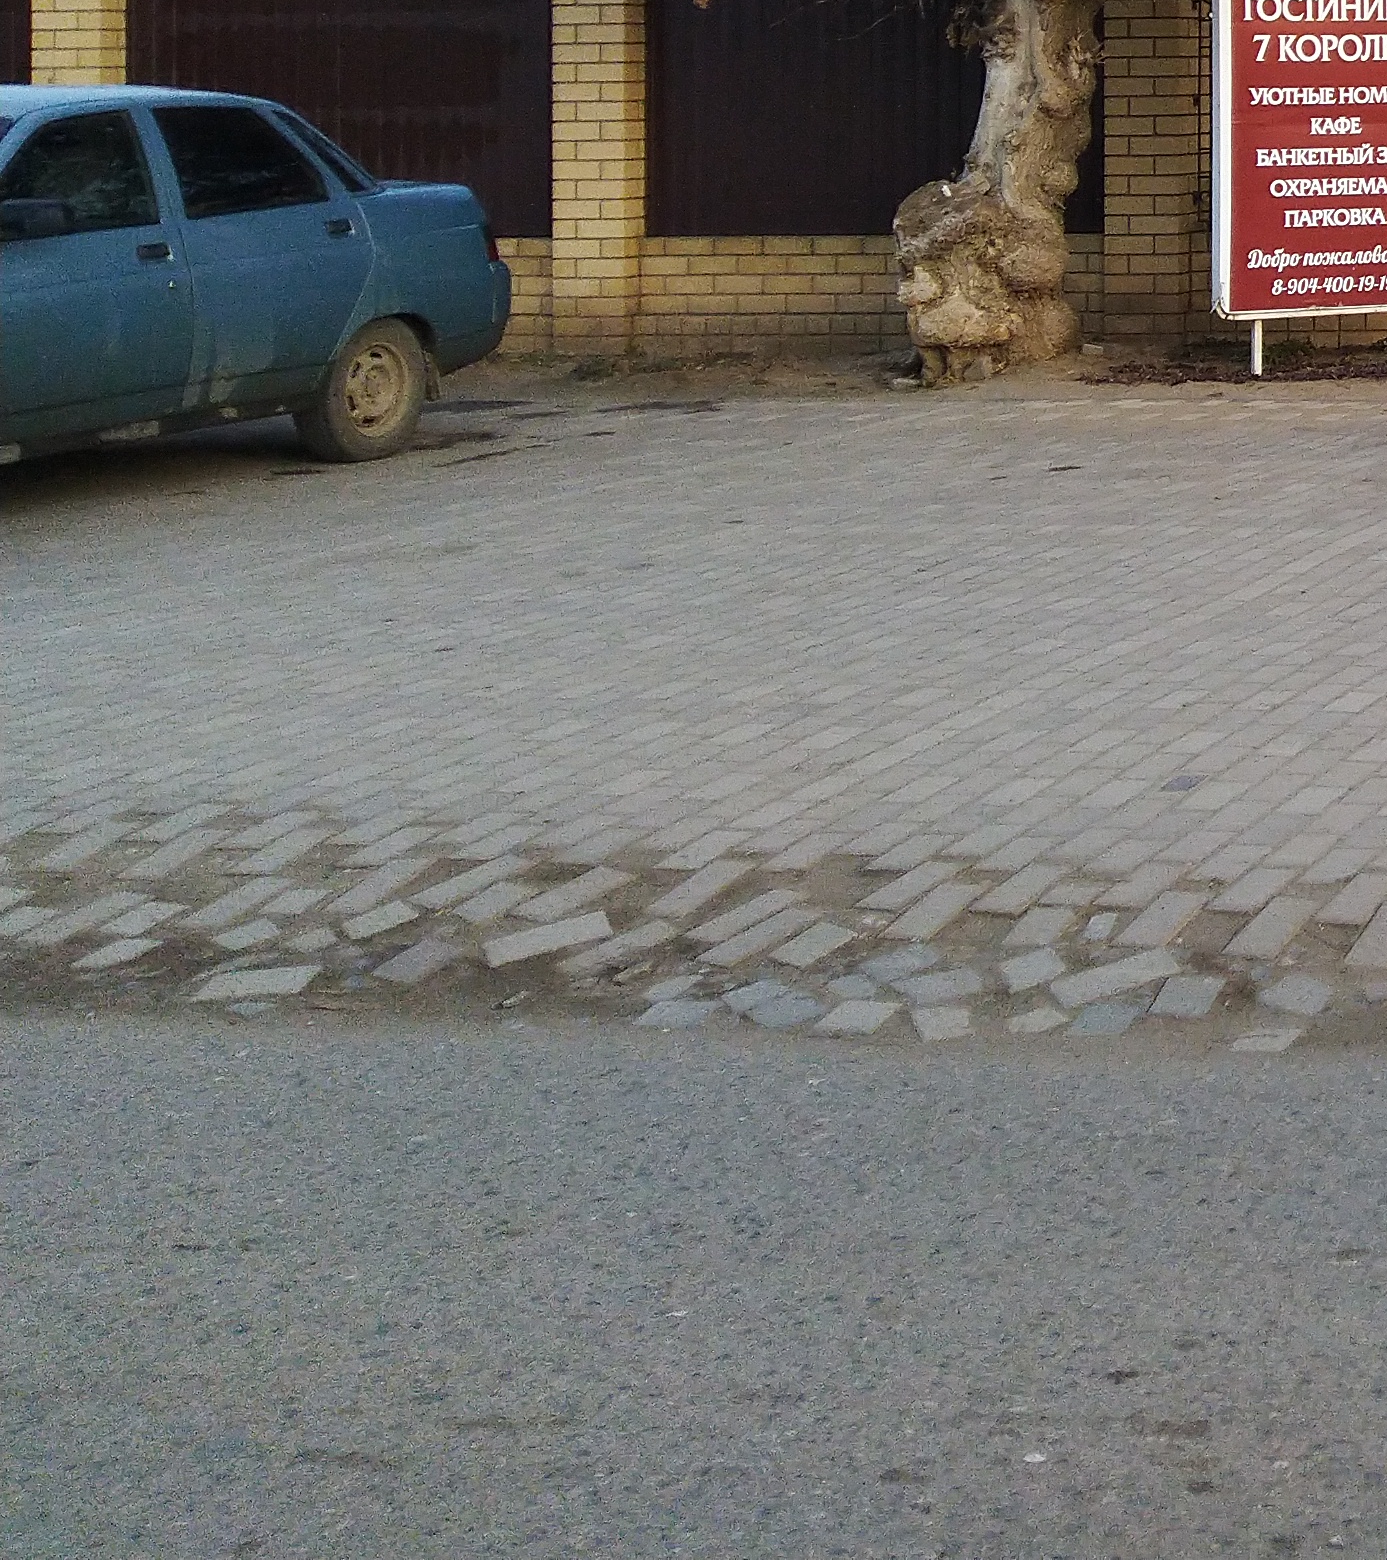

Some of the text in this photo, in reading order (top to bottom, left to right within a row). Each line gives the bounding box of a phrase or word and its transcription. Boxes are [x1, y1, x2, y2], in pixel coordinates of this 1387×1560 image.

[1252, 34, 1271, 62] 7
[1248, 86, 1337, 105] УЮТНЫЕ
[1310, 116, 1362, 135] КАФЕ
[1256, 143, 1374, 167] БАНКЕТНЫЙ
[1284, 207, 1387, 227] ПАРКОВКА
[1247, 248, 1301, 272] Добро
